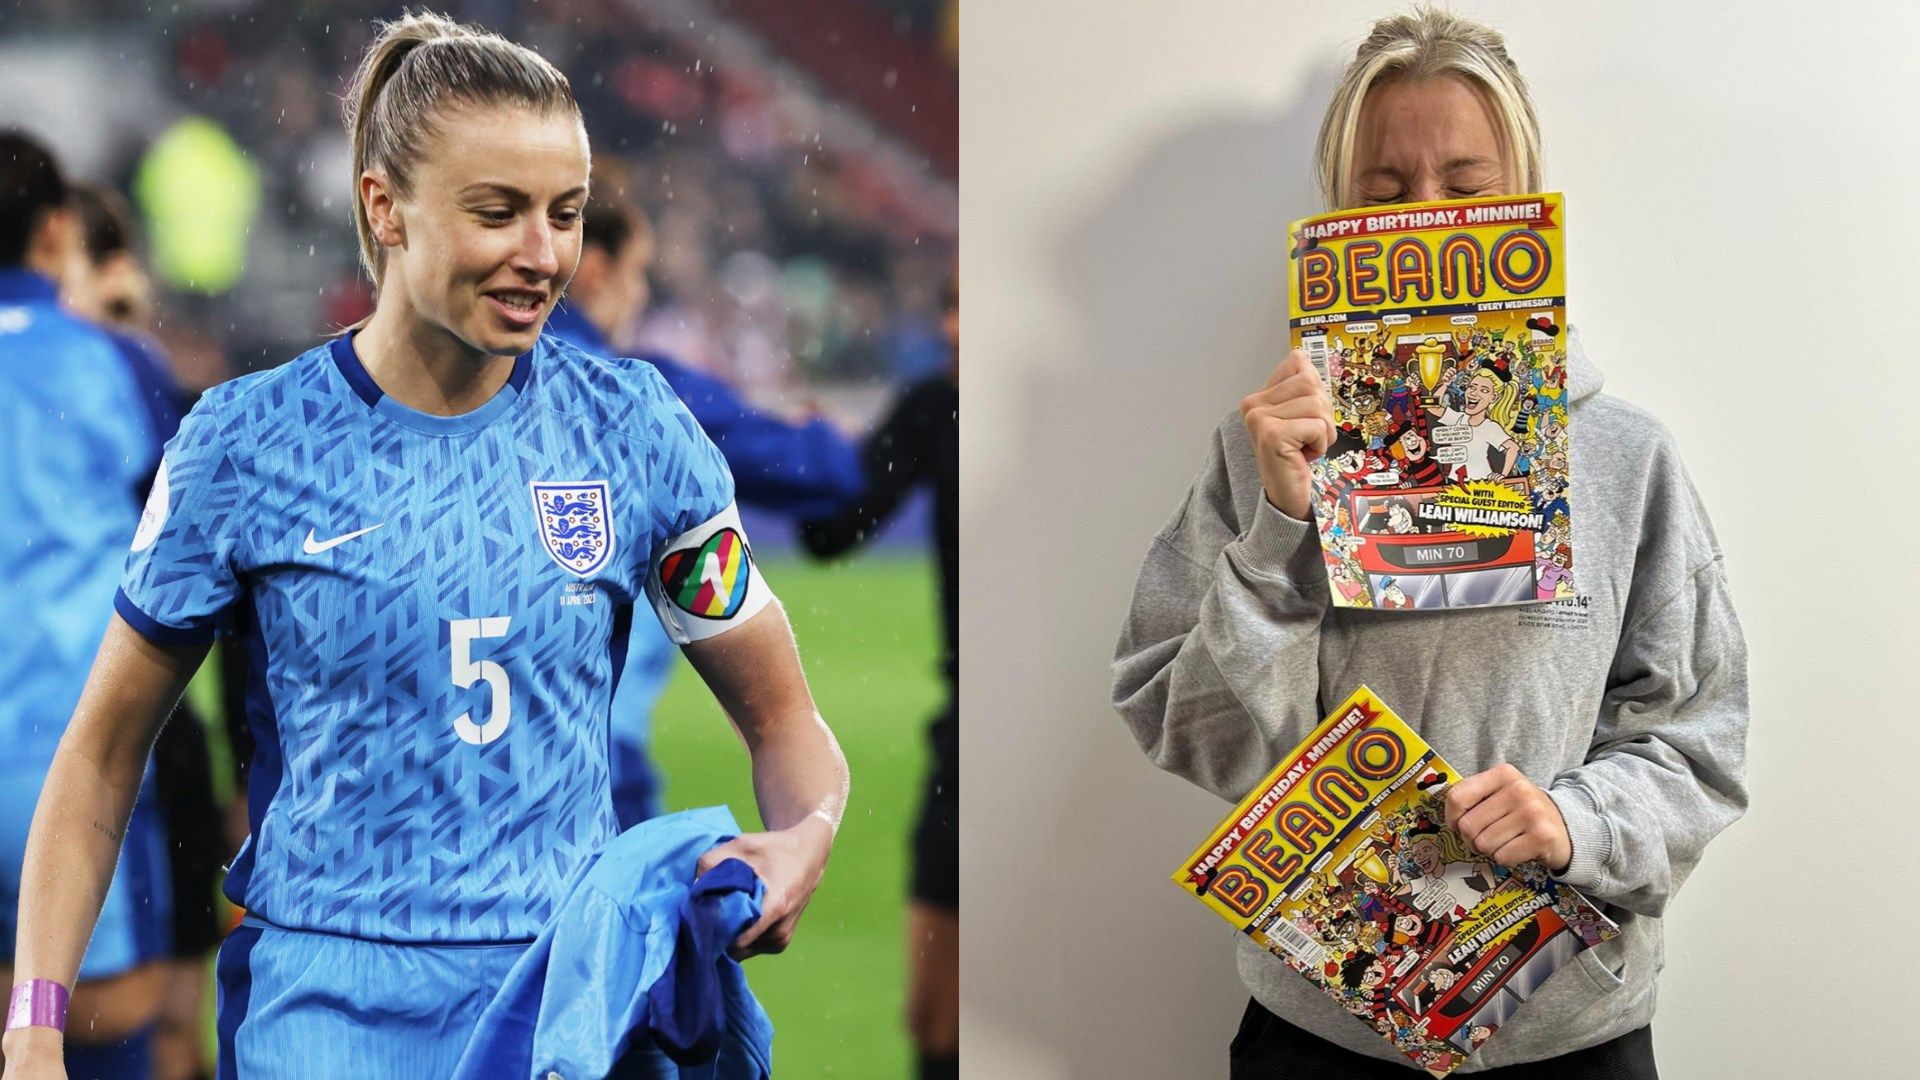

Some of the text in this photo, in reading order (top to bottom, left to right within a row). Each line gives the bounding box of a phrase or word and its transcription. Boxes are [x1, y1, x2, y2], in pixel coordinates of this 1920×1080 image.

[1304, 203, 1541, 239] HAPPY BIRTHDAY, MINNIE!
[1300, 229, 1552, 312] BEANO
[1300, 313, 1347, 326] BEANO.COM
[1478, 298, 1553, 312] EVERY WEDNESDAY
[1440, 495, 1526, 509] SPECIAL GUEST EDITOR
[1473, 489, 1494, 498] WITH
[1419, 503, 1544, 530] LEAH WILLIAMSON!
[1416, 546, 1465, 561] MIN 70
[567, 595, 582, 605] APRIL
[450, 616, 512, 745] 5
[1195, 707, 1365, 876] HAPPY BIRTHDAY, MINNIE!
[1371, 788, 1391, 807] EVERY
[1389, 758, 1426, 791] WEDNESDAY
[1208, 727, 1407, 918] BEANO
[1252, 892, 1288, 928] BEANO.COM
[1458, 893, 1528, 940] SPECIAL GUEST EDITOR
[1480, 903, 1499, 918] WITH
[1447, 938, 1480, 965] LEAH
[1476, 892, 1554, 944] WILLIAMSON!
[1471, 955, 1510, 993] MIN 70
